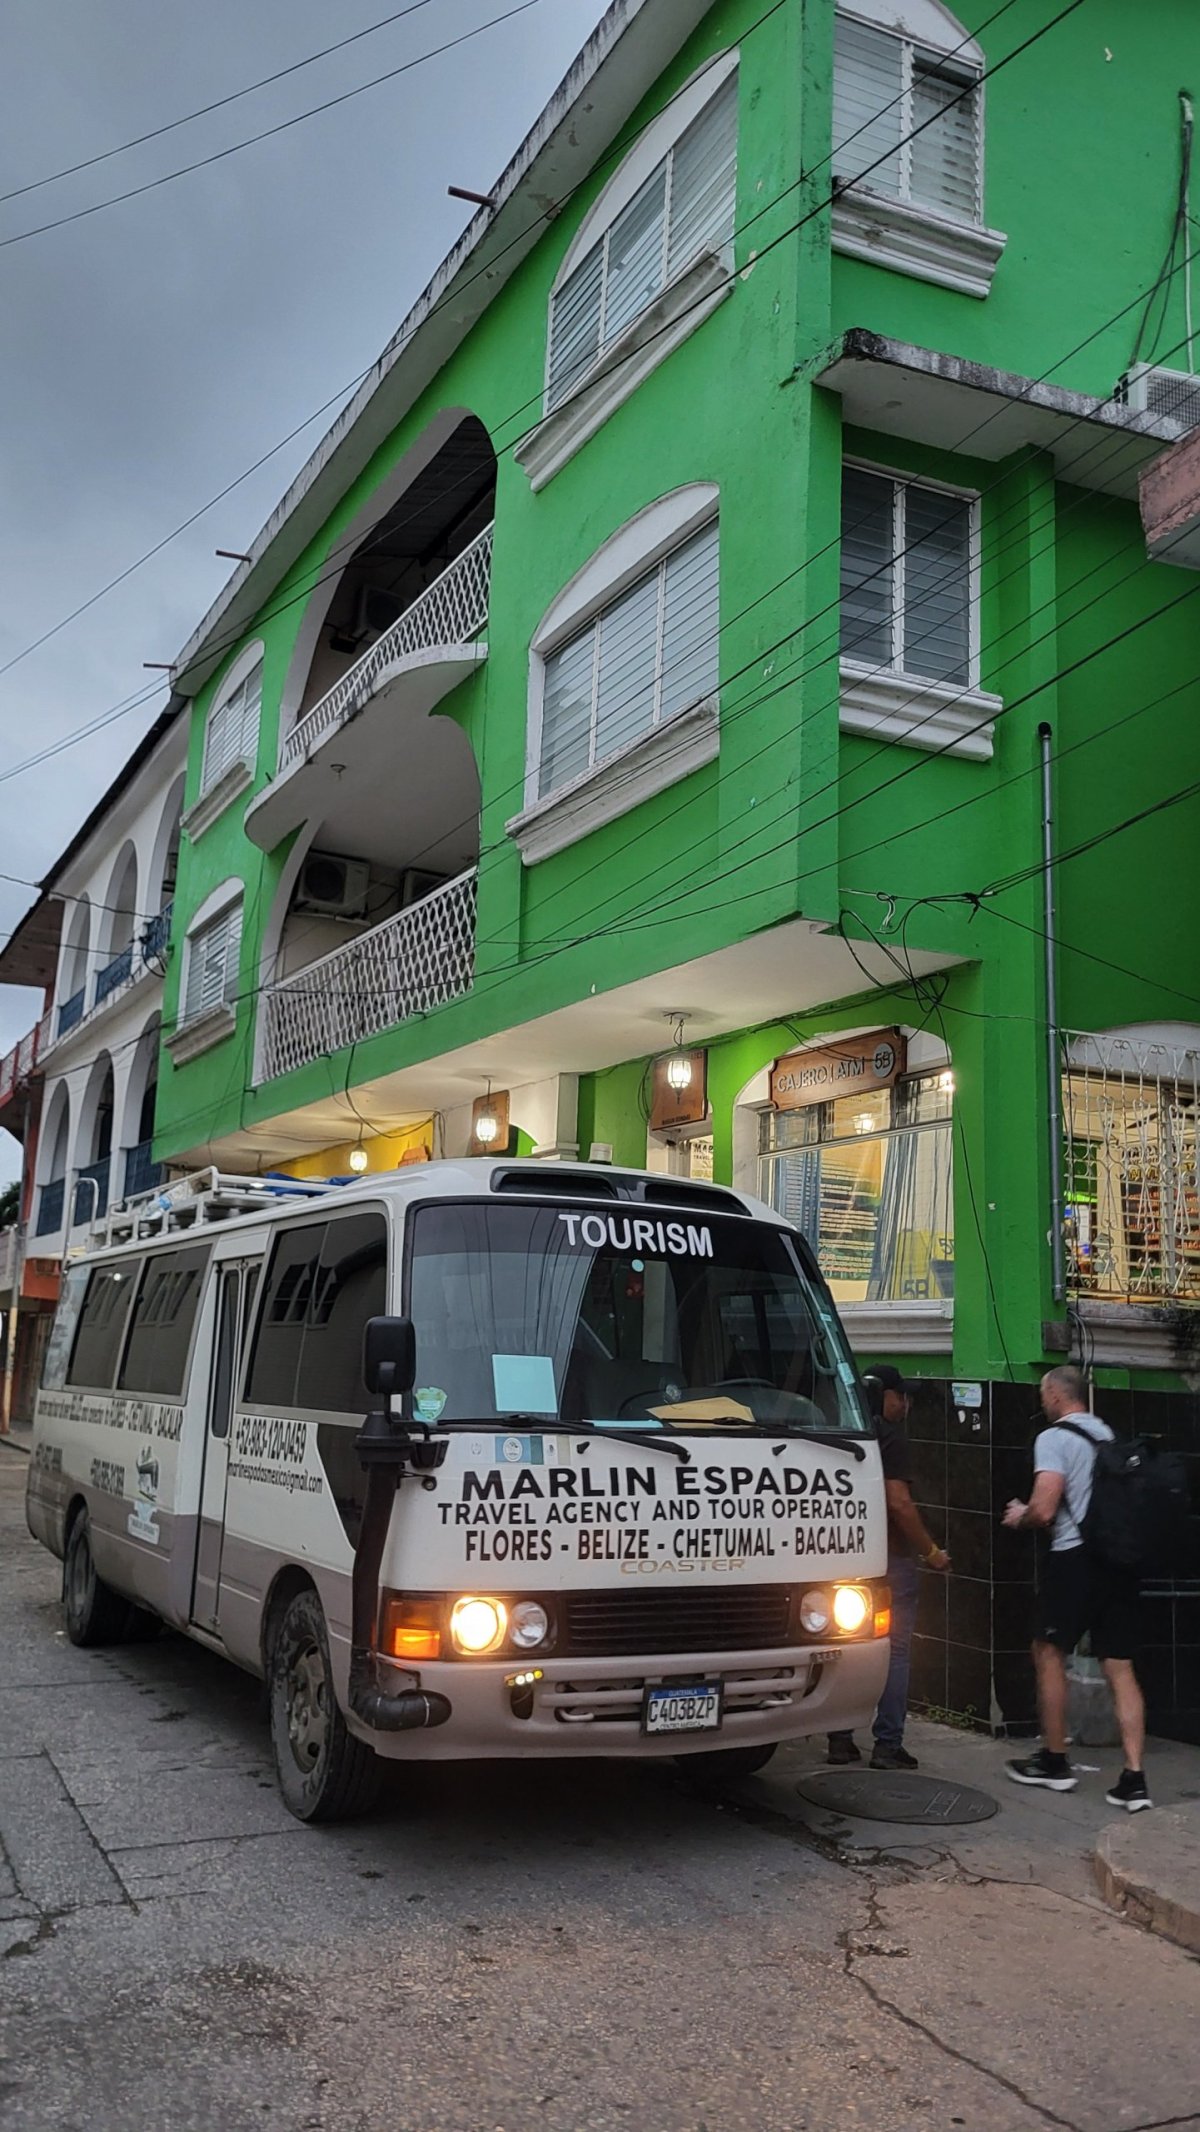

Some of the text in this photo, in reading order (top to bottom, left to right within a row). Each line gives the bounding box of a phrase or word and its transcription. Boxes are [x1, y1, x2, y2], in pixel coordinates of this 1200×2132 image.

[777, 1064, 828, 1093] CAJERO
[837, 1056, 865, 1080] ATM
[558, 1213, 714, 1258] TOURISM
[236, 1417, 307, 1464] +52-983-120-0459
[462, 1466, 854, 1501] MARLIN ESPADAS
[438, 1499, 868, 1524] TRAVEL AGENCY AND TOUR OPERATOR
[465, 1529, 552, 1561] FLORES
[578, 1529, 650, 1560] BELIZE
[673, 1527, 775, 1559] CHETUMAL
[795, 1525, 865, 1555] BACALAR
[620, 1558, 746, 1575] COASTER
[649, 1696, 715, 1722] C403BZP
